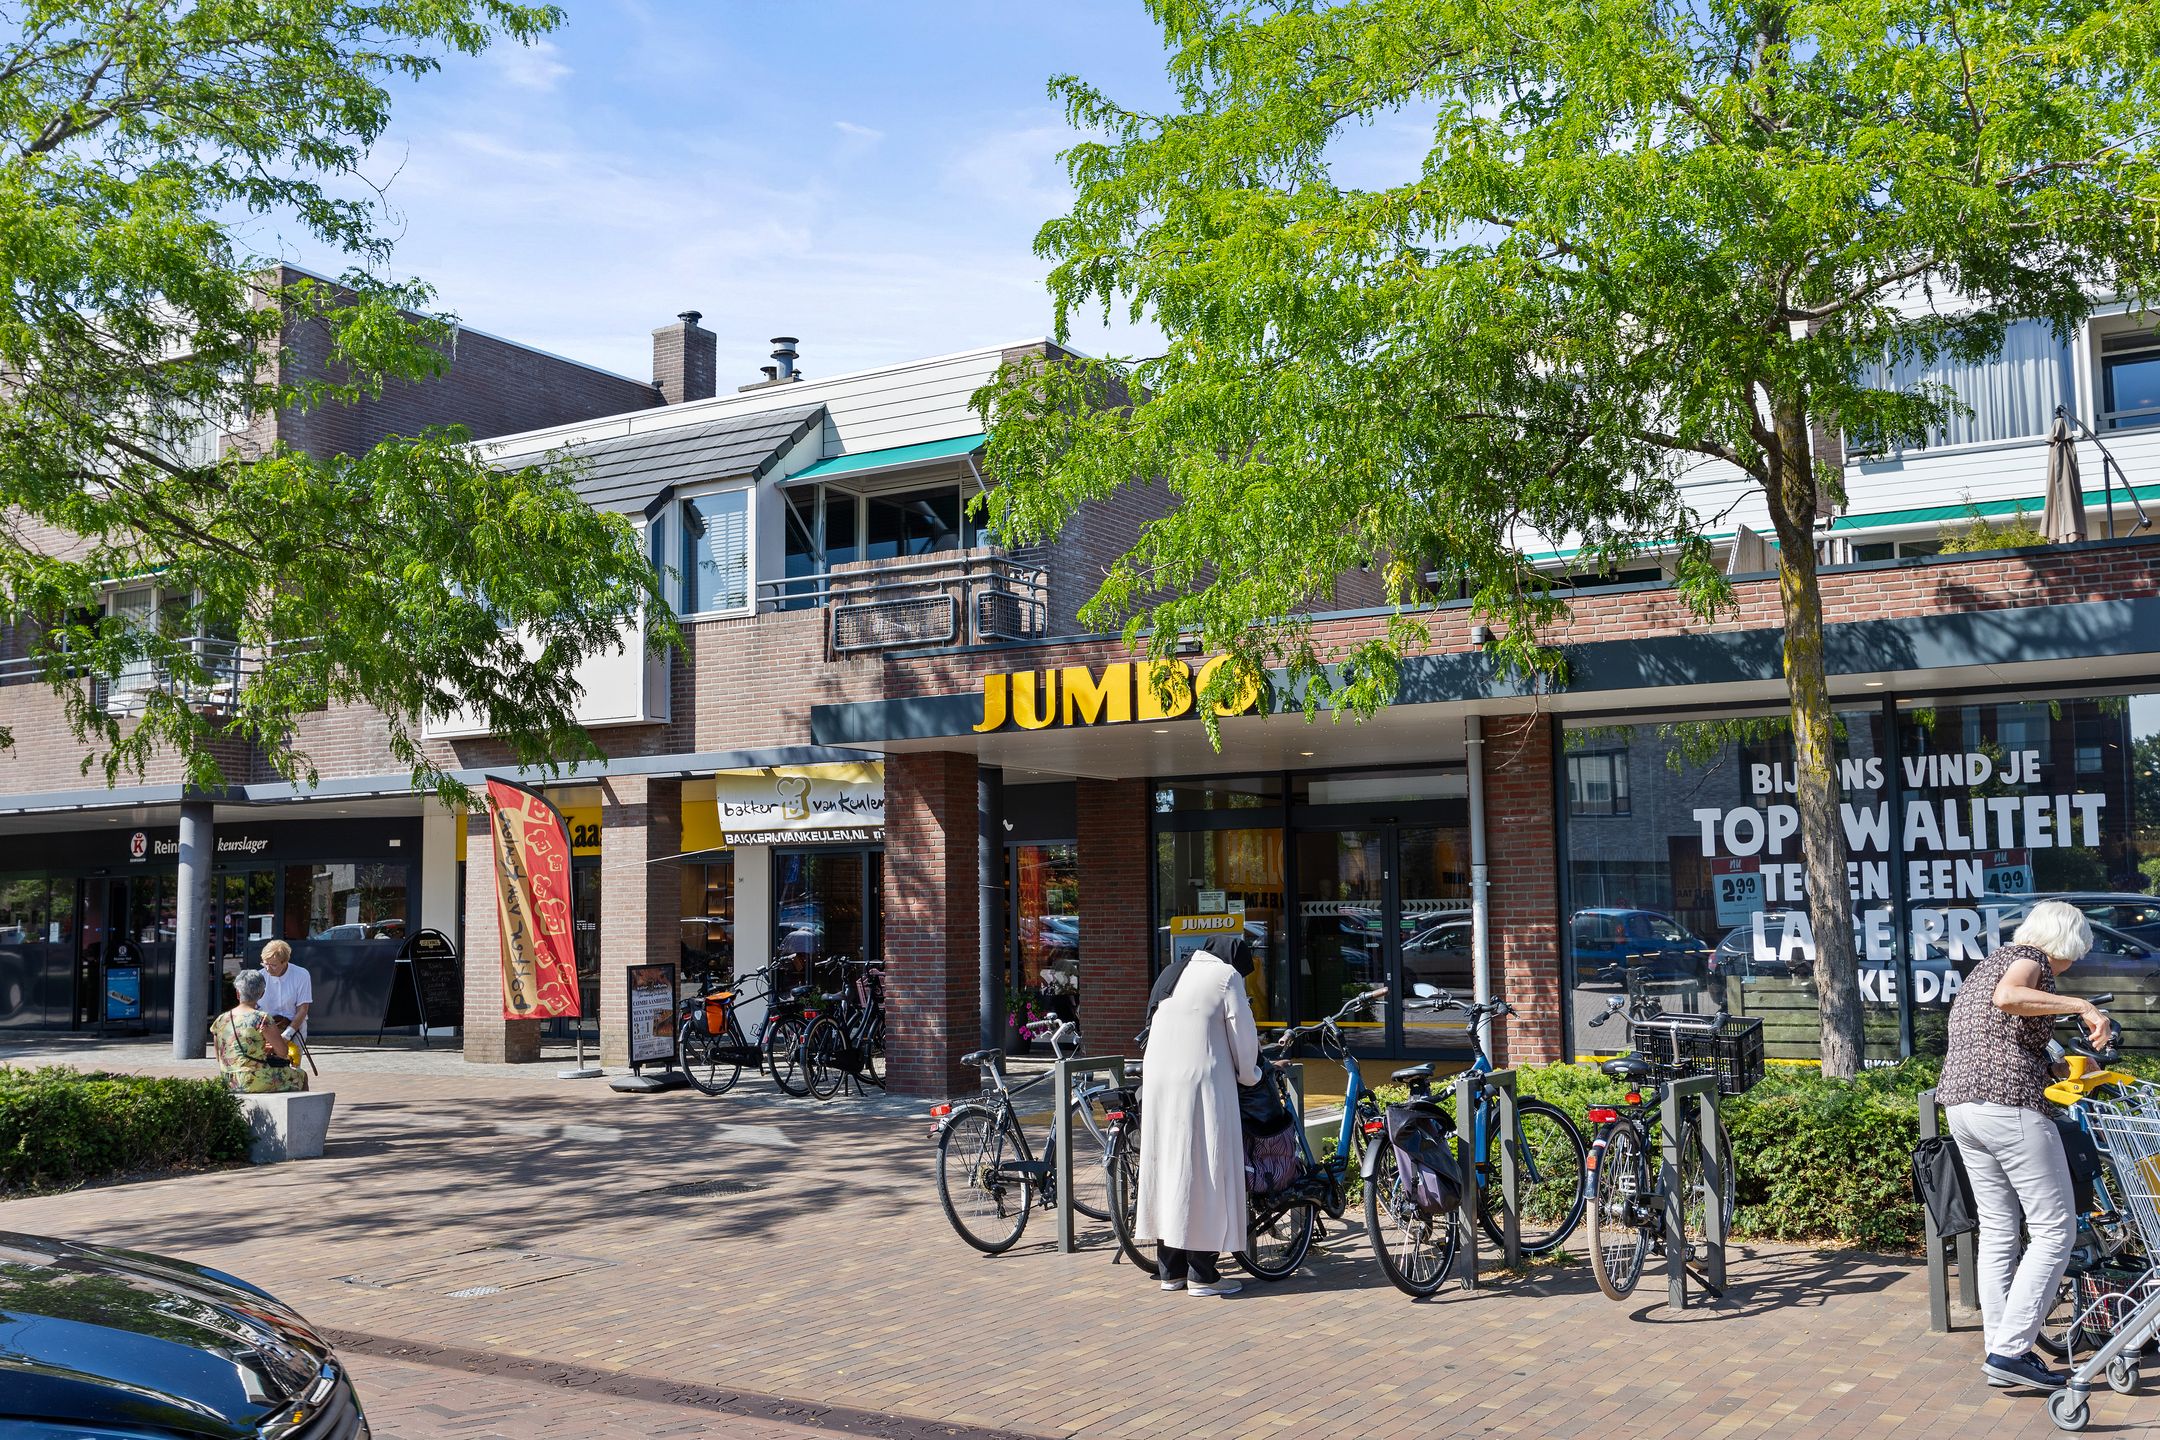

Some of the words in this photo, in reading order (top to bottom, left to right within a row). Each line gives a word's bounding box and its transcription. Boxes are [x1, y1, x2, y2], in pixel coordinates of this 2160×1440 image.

[972, 655, 1258, 733] JUMBO
[1836, 757, 1885, 790] NS
[1902, 752, 1992, 788] VIND
[2000, 750, 2041, 785] JE
[724, 800, 779, 817] bakker
[812, 799, 837, 812] van
[1693, 793, 2106, 857] TOPWALITEIT
[217, 836, 268, 854] keurslager
[568, 815, 602, 849] aa
[724, 829, 869, 845] BAKKERIJVANKEULEN.NL
[1722, 877, 1756, 902] 2.99
[1760, 861, 1890, 901] TEEN
[1908, 858, 1985, 899] EEN
[1181, 917, 1235, 931] JUMBO
[1752, 910, 1892, 961] LAE
[1911, 908, 2014, 961] PRI
[1915, 969, 1963, 1003] DA
